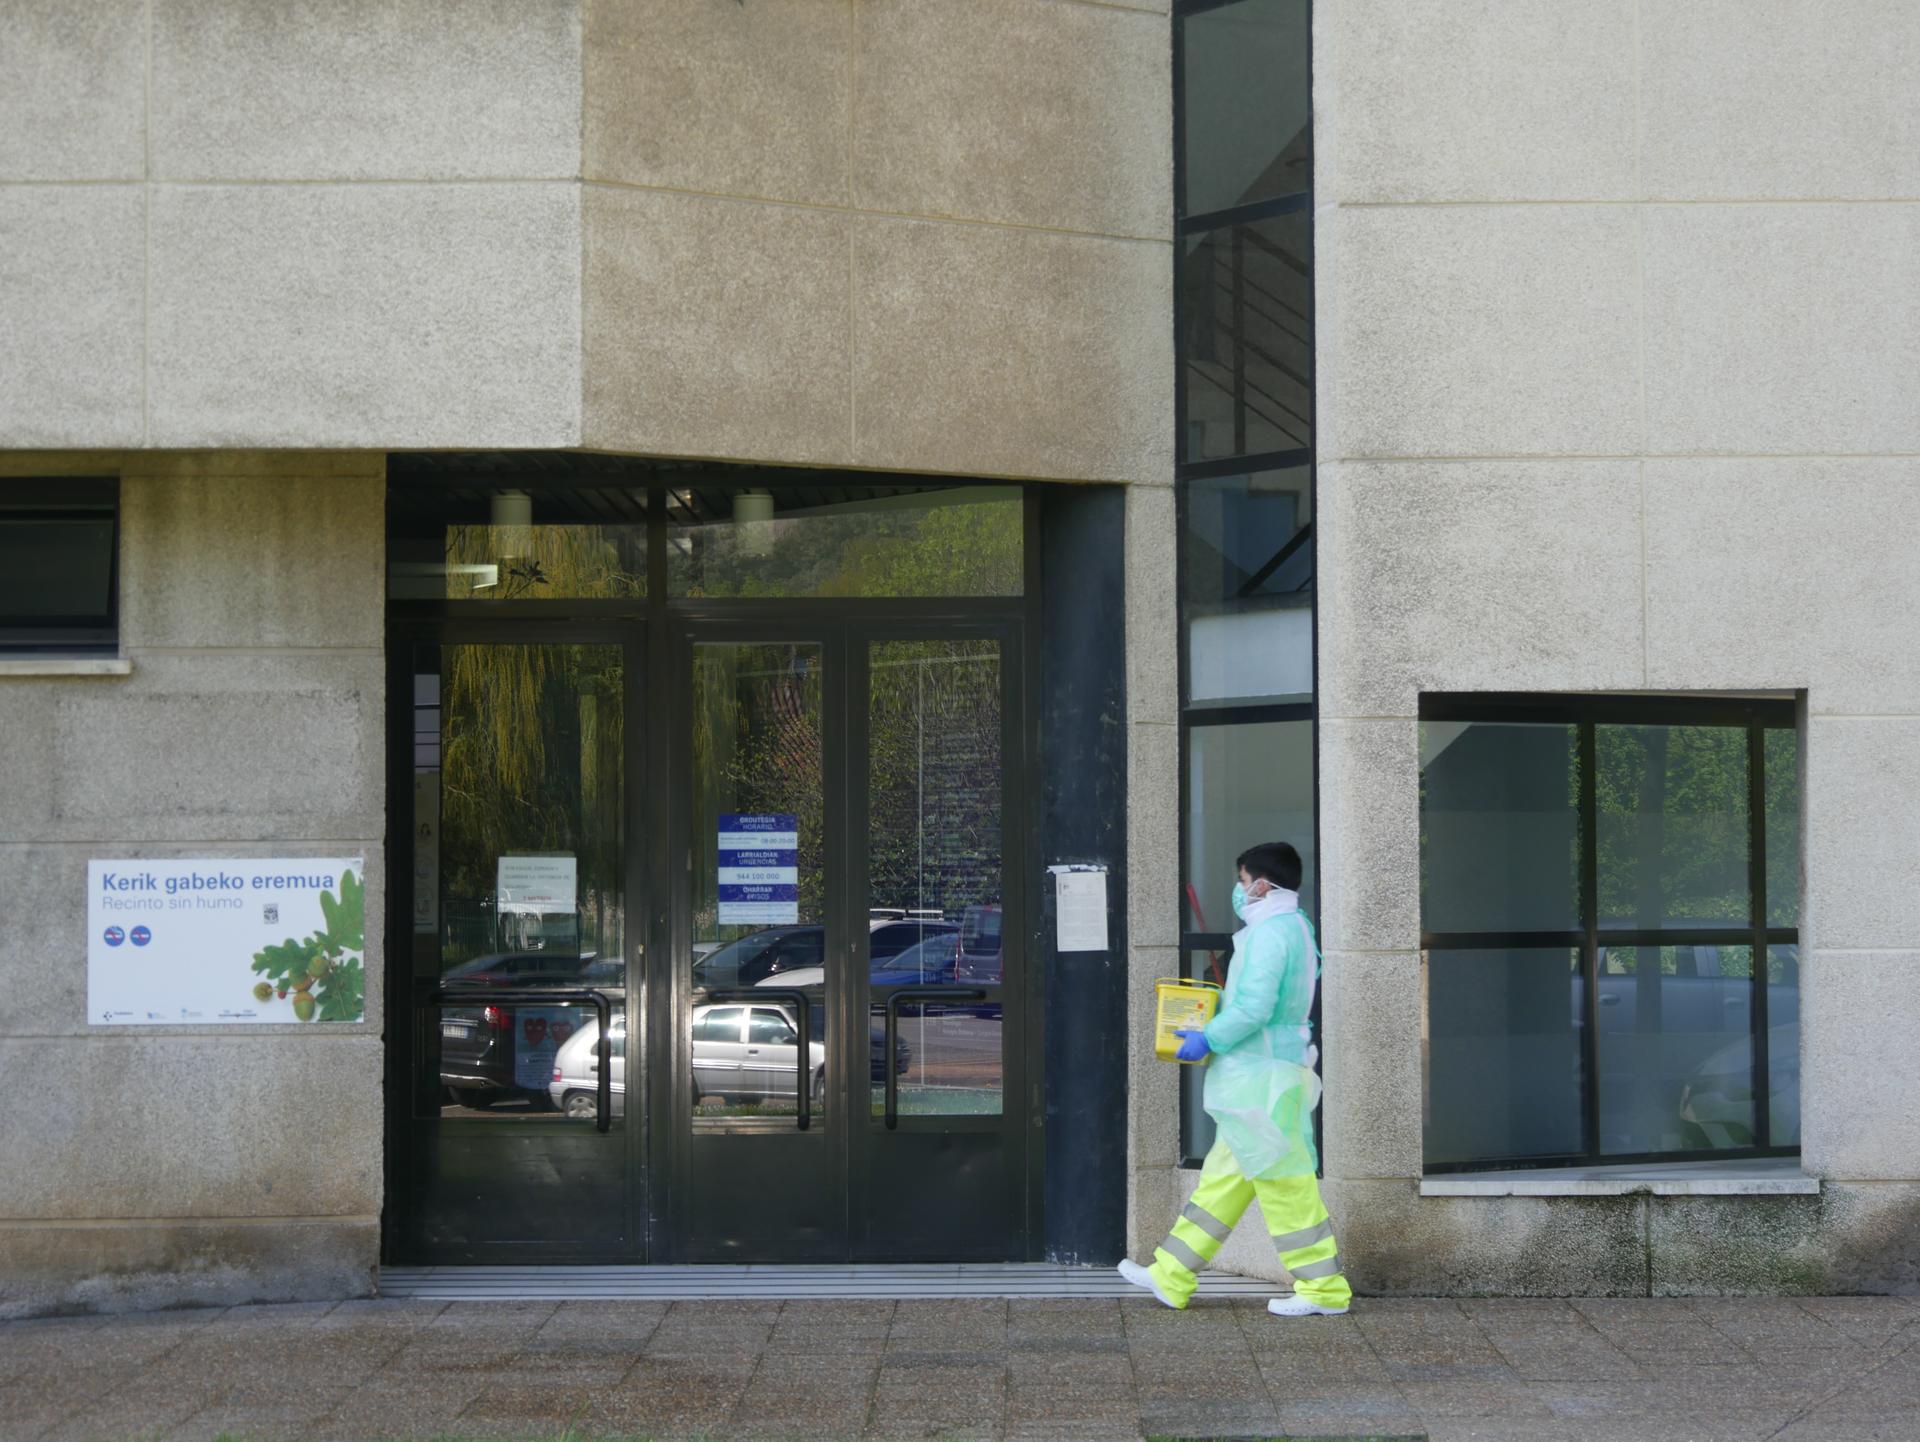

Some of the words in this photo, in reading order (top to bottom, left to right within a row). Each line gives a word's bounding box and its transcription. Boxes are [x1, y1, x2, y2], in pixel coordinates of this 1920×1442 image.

[102, 873, 157, 891] Kerik
[165, 872, 244, 894] gabeko
[252, 874, 334, 889] eremua
[102, 896, 164, 910] Recinto
[168, 896, 192, 909] sin
[196, 896, 243, 909] humo
